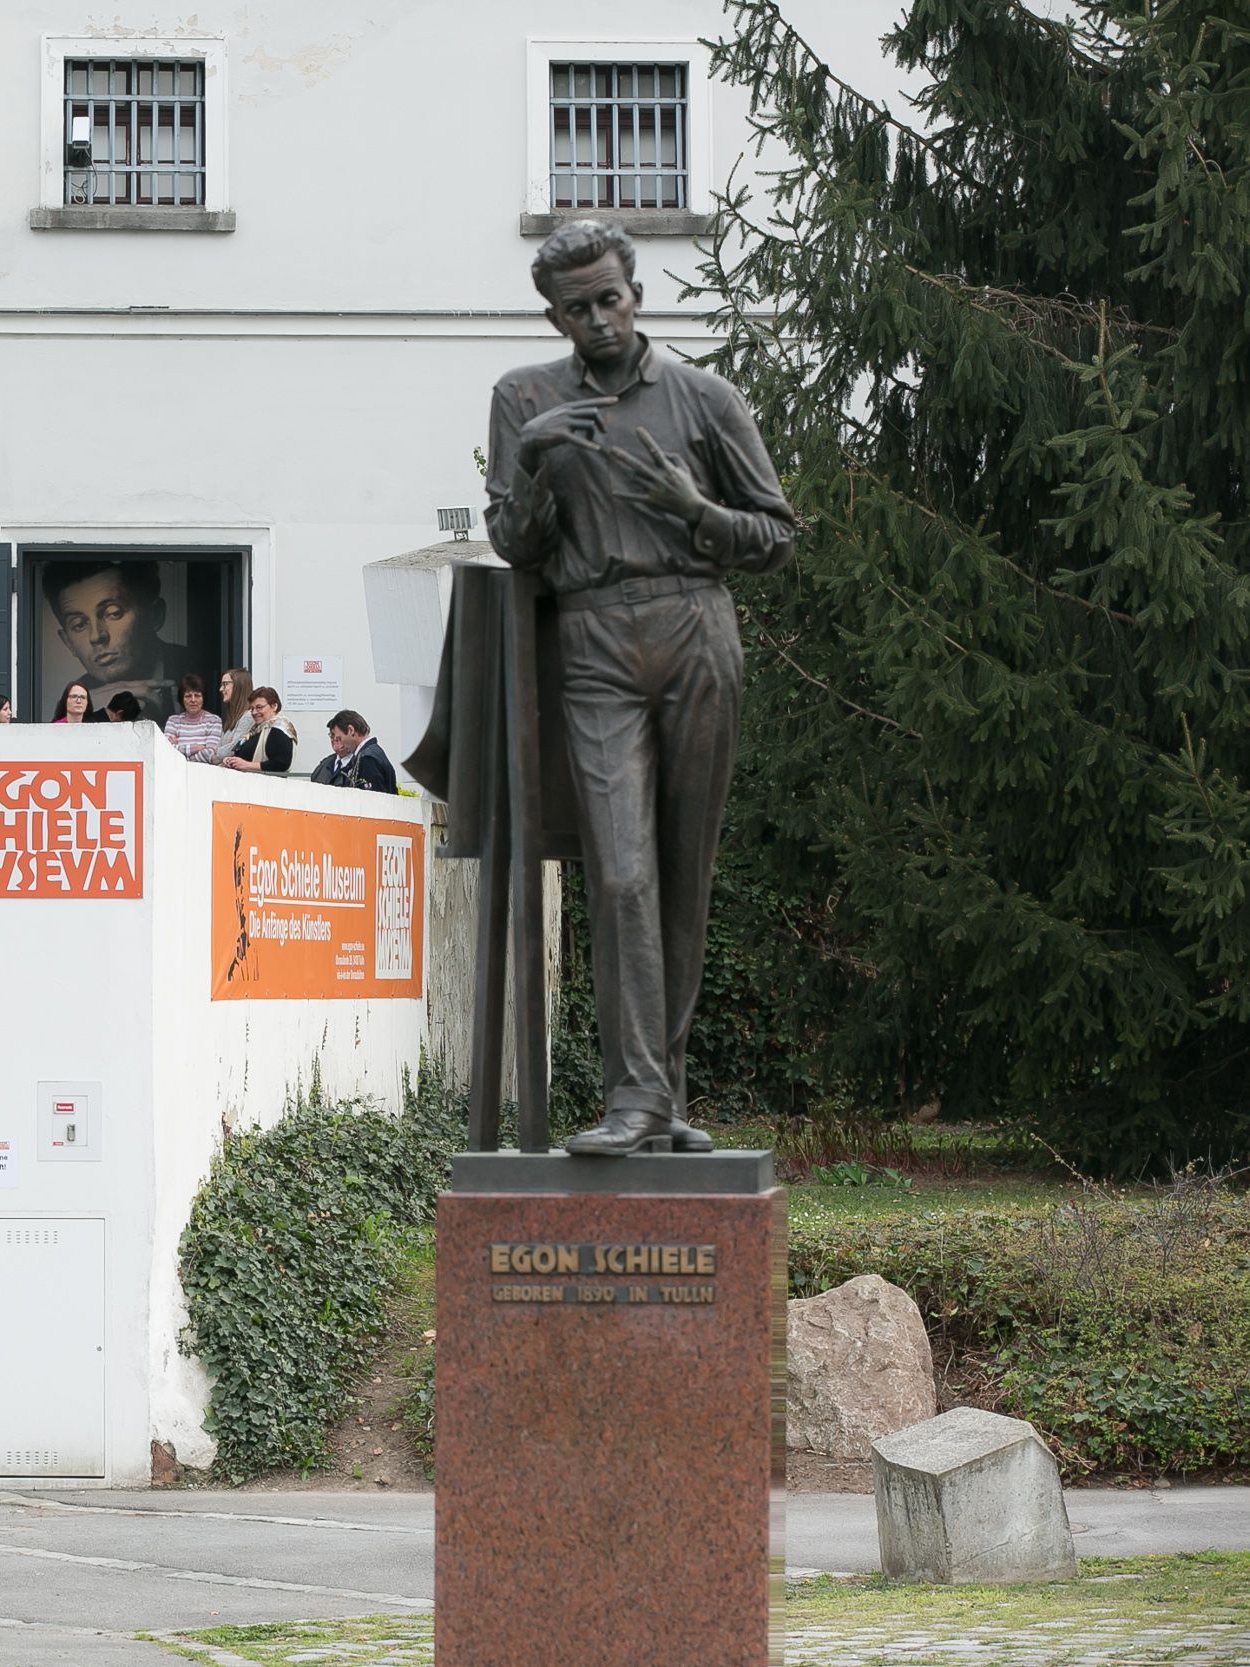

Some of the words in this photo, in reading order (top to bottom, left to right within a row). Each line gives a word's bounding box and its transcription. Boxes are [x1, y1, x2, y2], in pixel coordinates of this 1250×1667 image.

[249, 845, 278, 907] Egon
[280, 848, 320, 898] Schiele
[322, 852, 365, 901] Museum
[381, 846, 407, 887] EGON
[249, 910, 261, 938] Die
[289, 912, 301, 940] des
[302, 913, 332, 941] Künstlers
[378, 887, 410, 929] SCHIELE
[491, 1244, 579, 1273] EGON
[593, 1244, 717, 1274] SCHIELE
[492, 1285, 564, 1302] GEBOREN
[576, 1285, 616, 1302] 1890
[629, 1286, 650, 1302] IN
[660, 1286, 715, 1303] TULLN
